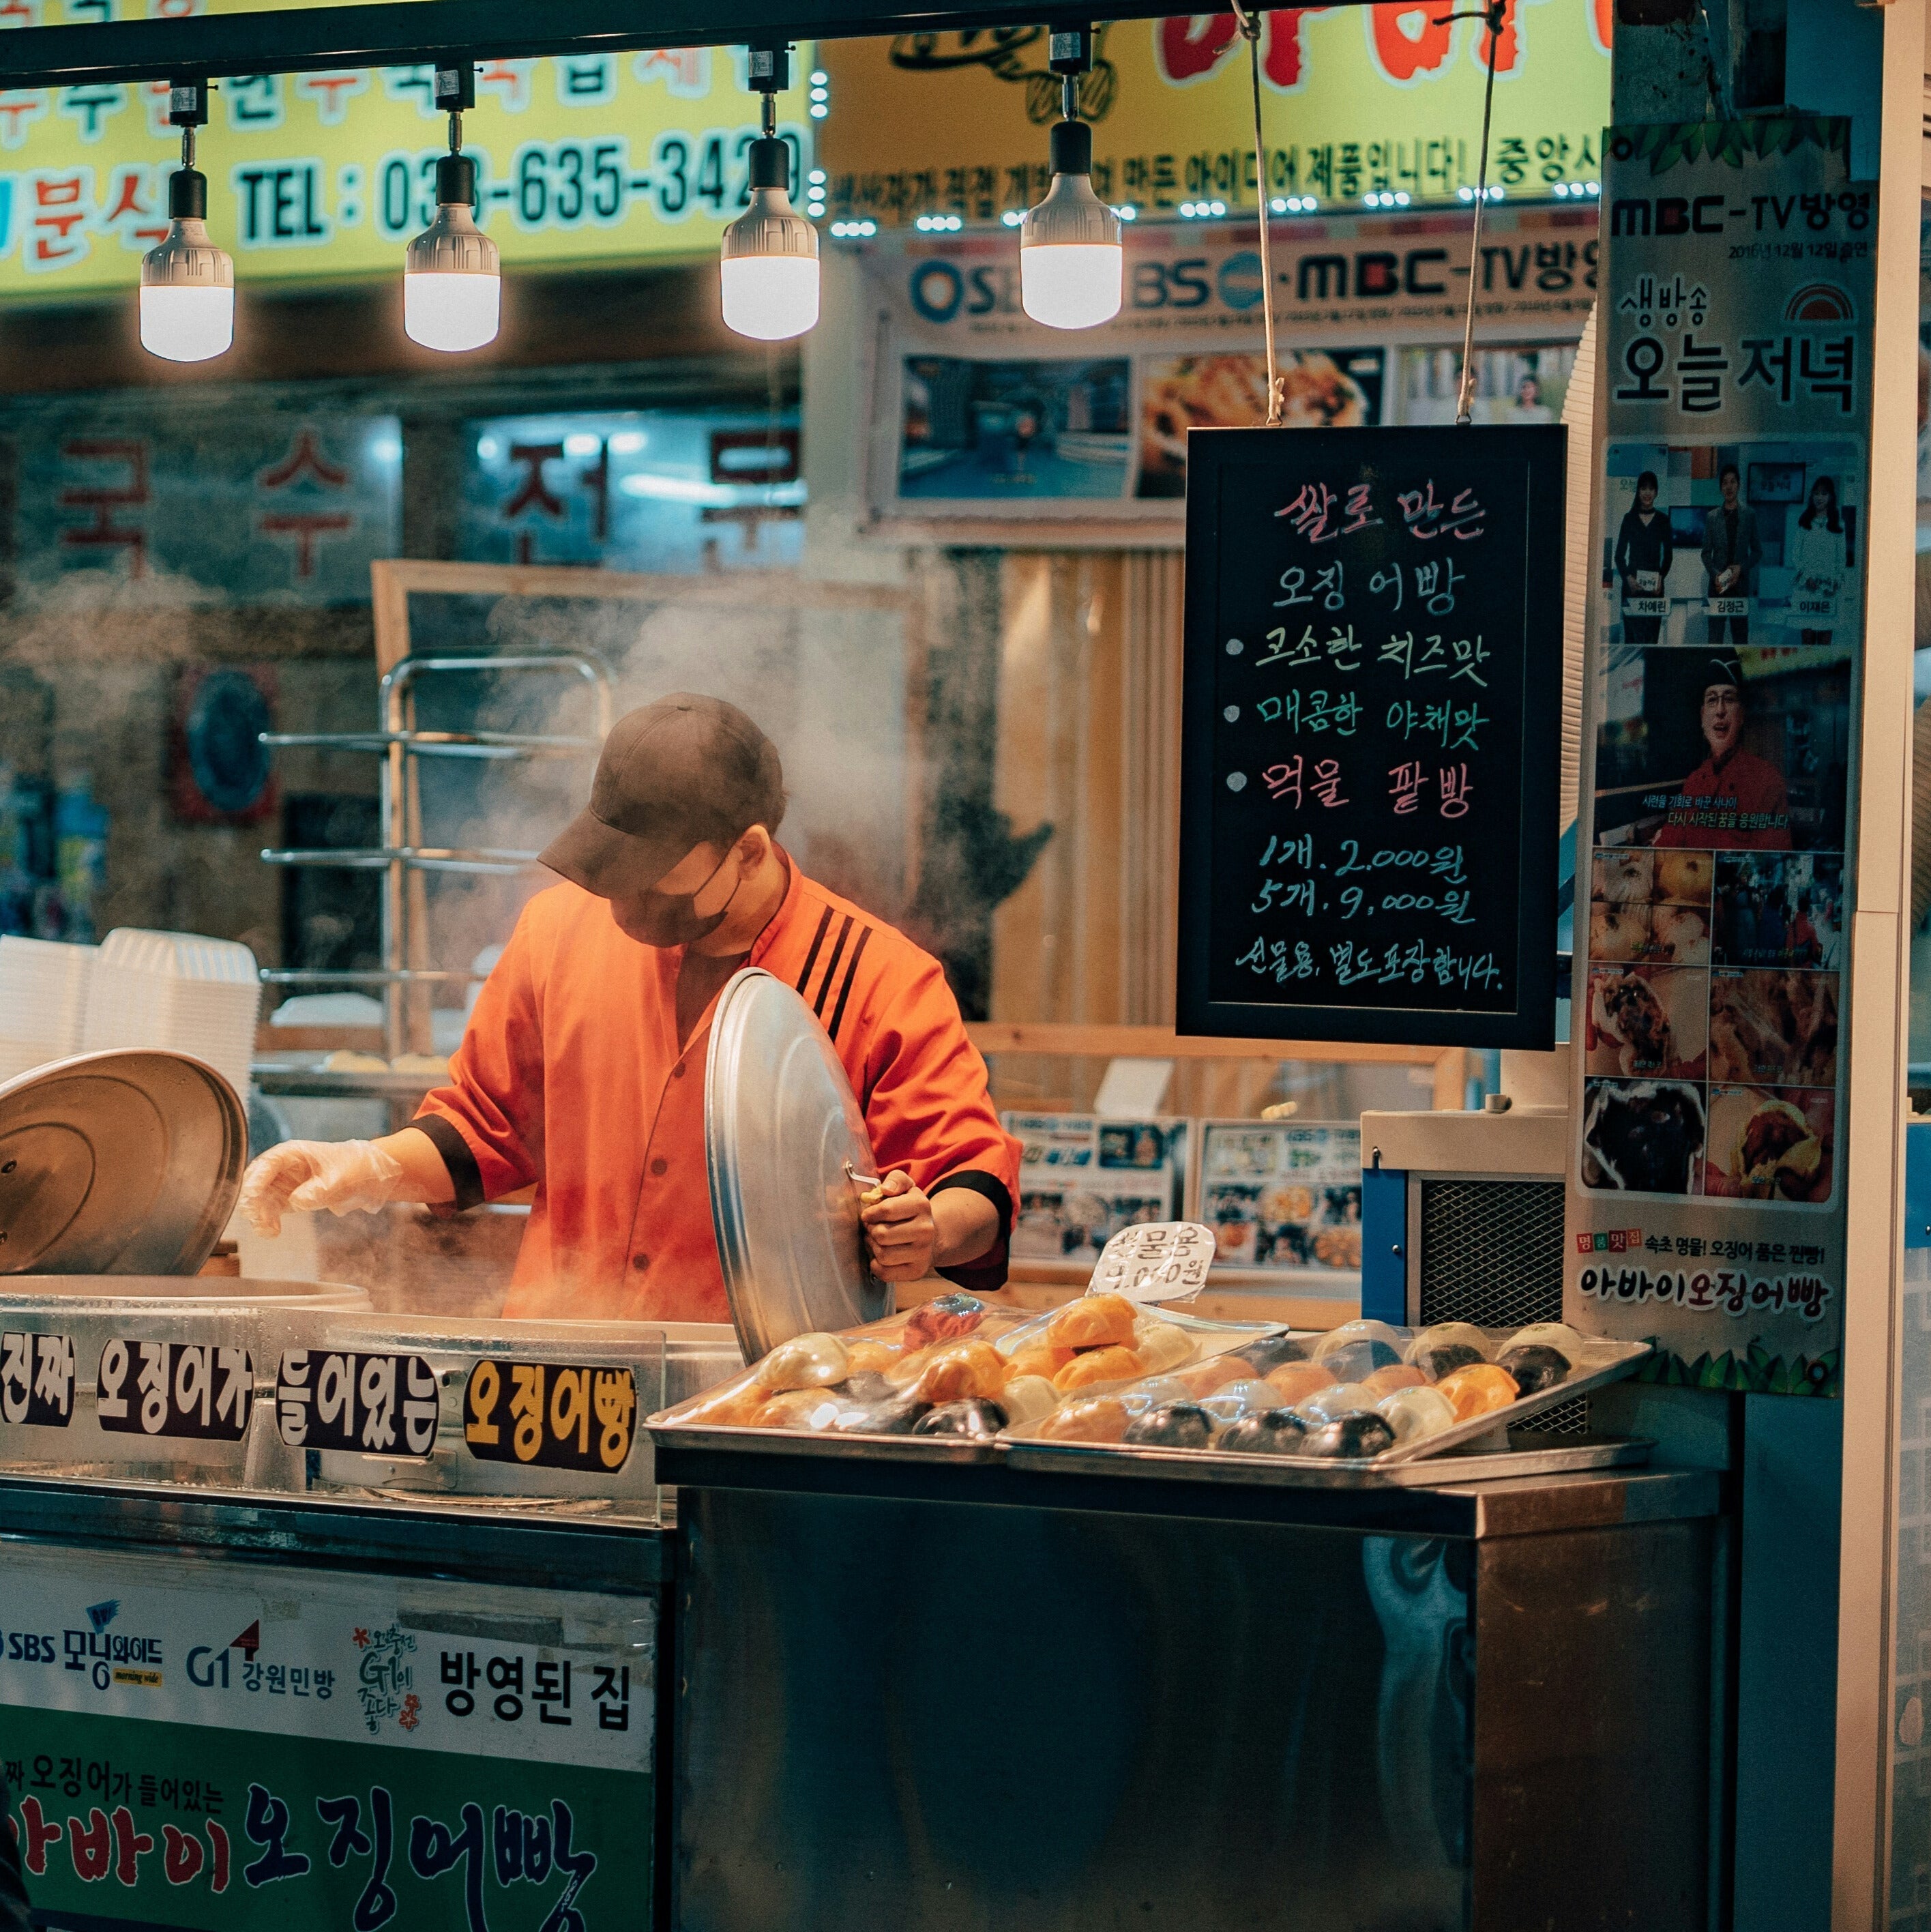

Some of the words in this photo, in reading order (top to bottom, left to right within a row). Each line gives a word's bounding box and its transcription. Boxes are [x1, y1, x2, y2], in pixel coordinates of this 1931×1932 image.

[1306, 136, 1466, 198] 제품입니다!
[1621, 277, 1707, 327] 생방송
[1617, 334, 1728, 412] 오늘
[1738, 336, 1854, 412] 저녁
[60, 430, 352, 580] 국수
[1273, 482, 1383, 544] 쌀로
[1397, 478, 1486, 540] 만든
[1638, 600, 1666, 613] 차예린
[1717, 600, 1745, 613] 김정근
[1377, 630, 1491, 687] 치즈맛
[1256, 688, 1363, 736] 매콤한
[1386, 699, 1490, 750] 야채맛
[1262, 755, 1349, 810] 먹물
[1667, 812, 1687, 827] 다시
[1645, 1234, 1674, 1254] 속초
[1675, 1237, 1706, 1257] 명물!
[1710, 1240, 1753, 1261] 오징어
[1756, 1243, 1786, 1263] 품은
[1, 1333, 74, 1424] 진짜
[98, 1338, 253, 1434] 오징어가
[280, 1349, 437, 1453] 들어있는
[467, 1360, 638, 1468] 오징어빵
[9, 1632, 55, 1664] SBS
[186, 1646, 229, 1688] G1
[242, 1663, 336, 1700] 강원민방
[439, 1650, 574, 1727] 방영된
[591, 1665, 631, 1732] 집
[31, 1754, 133, 1804] 오징어가
[138, 1774, 224, 1815] 들어있는
